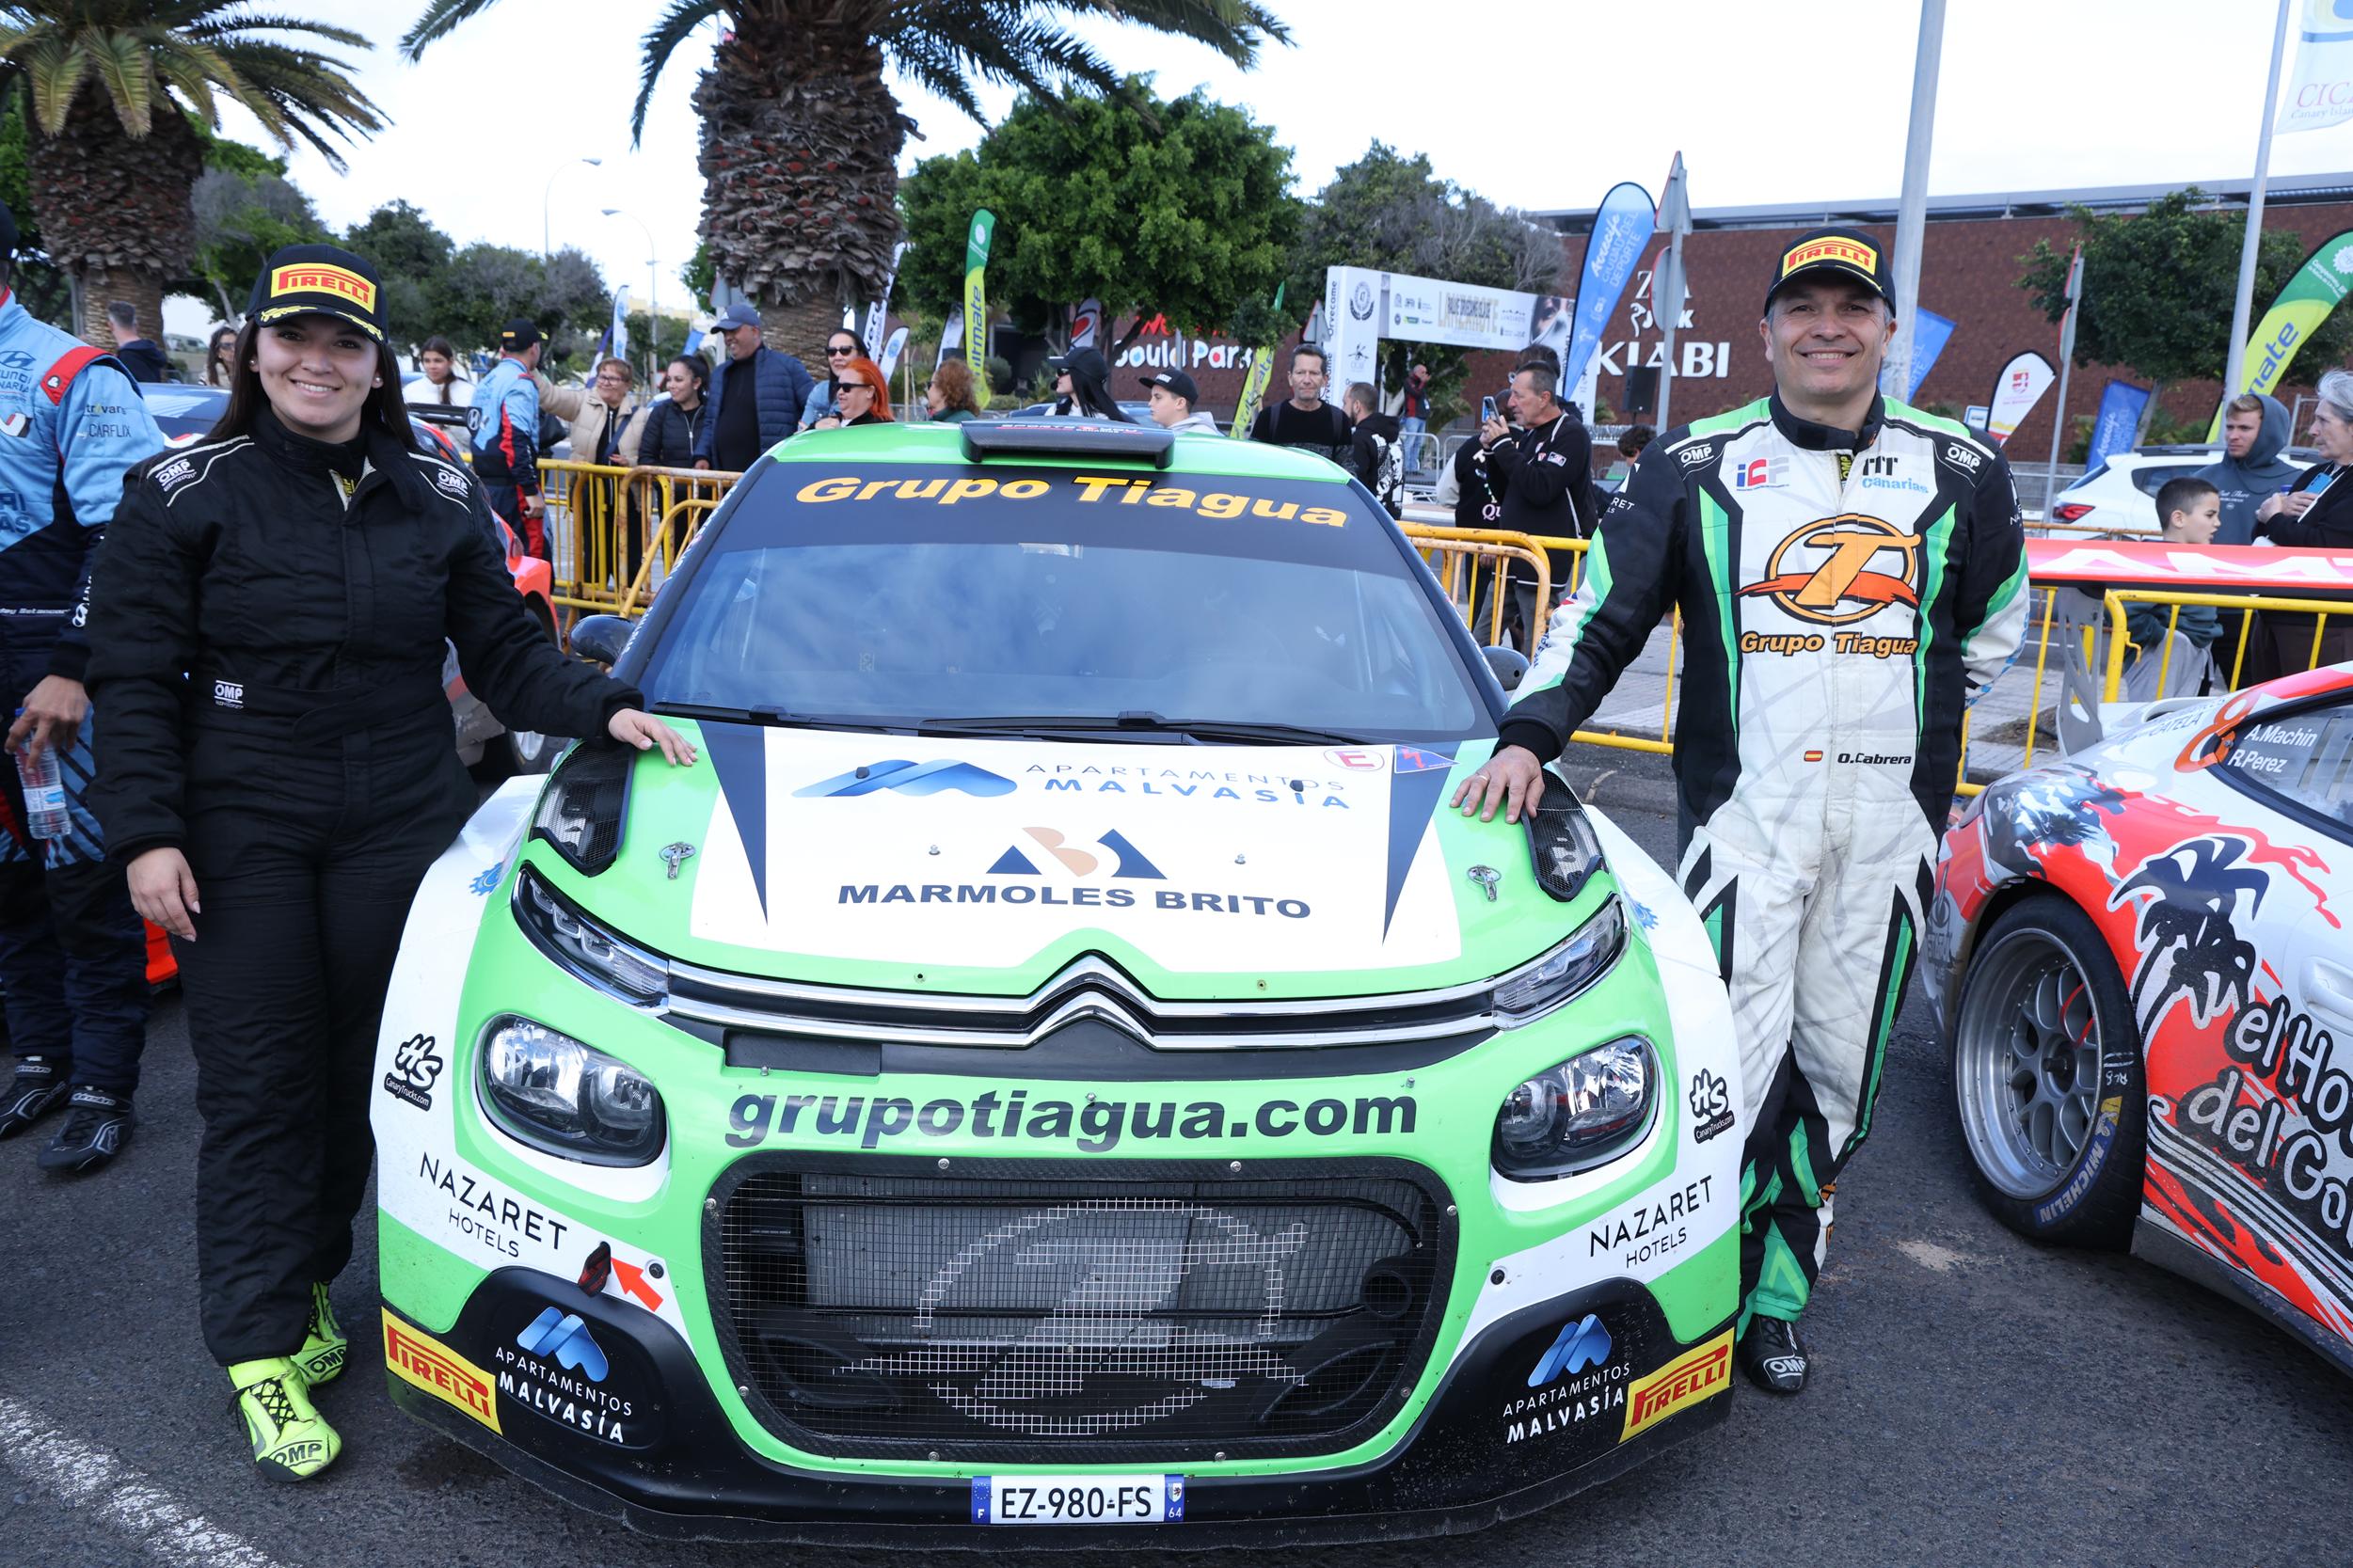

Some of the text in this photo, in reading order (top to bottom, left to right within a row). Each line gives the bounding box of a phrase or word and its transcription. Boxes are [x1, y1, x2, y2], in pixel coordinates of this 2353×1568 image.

[2297, 81, 2353, 108] CIC
[1610, 231, 1642, 288] DEPORTE
[1789, 241, 1870, 268] PIRELLI
[278, 267, 370, 304] PIRELLI
[1598, 341, 1730, 377] KIABI
[158, 460, 191, 483] OMP
[1680, 446, 1712, 464] OMP
[1947, 446, 1980, 468] OMP
[437, 470, 469, 490] OMP
[795, 477, 1347, 529] Grupo Tiagua
[1740, 630, 1919, 657] Grupo Tiagua
[215, 684, 244, 700] OMP
[1026, 764, 1345, 791] APARTAMENTOS
[838, 884, 1311, 919] MARMOLES BRITO
[386, 1077, 429, 1107] CanaryTrucks.com
[2285, 1020, 2353, 1142] Ho
[724, 1088, 1417, 1153] grupotiagua.com
[1695, 1115, 1734, 1139] CanaryTrucks.com
[420, 1151, 567, 1250] NAZARET
[2040, 1141, 2105, 1223] MICHELIN
[2284, 1134, 2353, 1243] Go
[448, 1208, 519, 1258] HOTELS
[1590, 1176, 1713, 1257] NAZARET
[1626, 1227, 1687, 1269] HOTELS
[310, 1348, 347, 1374] OMP
[387, 1323, 491, 1418] PIRELLI
[495, 1346, 632, 1417] APARTAMENTOS
[1502, 1362, 1630, 1418] APARTAMENTOS
[1630, 1344, 1729, 1428] PIRELLI
[499, 1370, 624, 1444] MALVASÍA
[1506, 1385, 1624, 1445] MALVASÍA
[274, 1442, 323, 1466] OMP
[978, 1486, 1183, 1519] F EZ-980-FS 64
